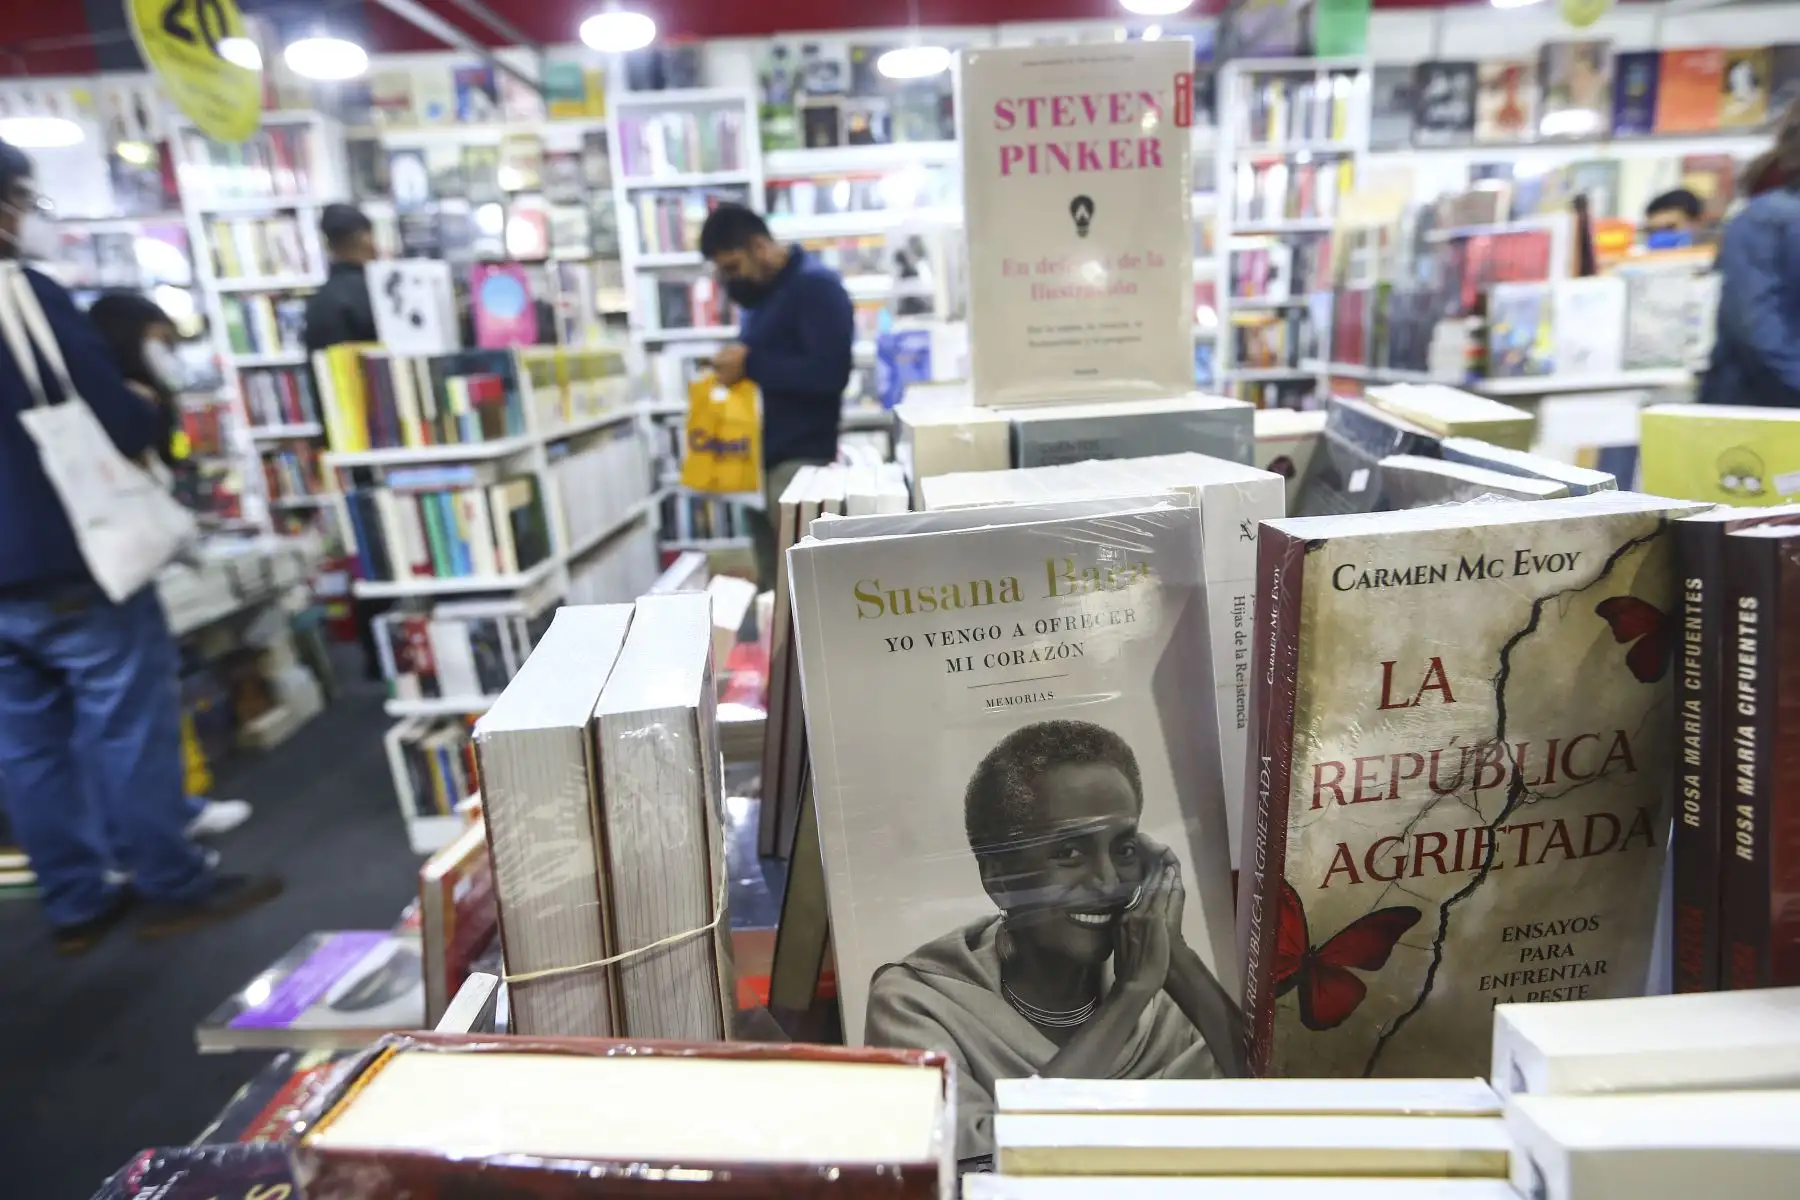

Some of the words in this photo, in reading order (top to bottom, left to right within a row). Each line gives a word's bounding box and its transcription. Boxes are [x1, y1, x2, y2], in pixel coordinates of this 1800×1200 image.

[994, 89, 1165, 131] STEVEN
[1000, 137, 1164, 176] PINKER
[1332, 563, 1447, 593] CARMEN
[1513, 547, 1582, 577] EVOY
[853, 576, 1025, 621] Susana
[1230, 595, 1246, 629] Hijas
[884, 635, 915, 653] YO
[924, 624, 1003, 648] VENGO
[1012, 622, 1027, 638] A
[1034, 608, 1137, 635] OFRECER
[1235, 631, 1247, 645] de
[1684, 577, 1703, 691] CIFUENTES
[945, 656, 975, 674] MI
[983, 641, 1086, 670] CORAZÓN
[1235, 648, 1248, 660] la
[1737, 596, 1759, 717] CIFUENTES
[985, 690, 1055, 709] MEMORIAS
[1376, 656, 1457, 711] LA
[1680, 700, 1701, 767] MARÍA
[1310, 729, 1639, 810] REPÚBLICA
[1733, 725, 1757, 797] MARÍA
[1253, 754, 1272, 890] AGRIETADA
[1684, 775, 1701, 827] ROSA
[1317, 806, 1658, 890] AGRIETADA
[1735, 804, 1755, 861] ROSA
[1502, 914, 1601, 942] ENSAYOS
[1478, 959, 1608, 991] ENFRENTAR
[1519, 942, 1575, 963] PARA
